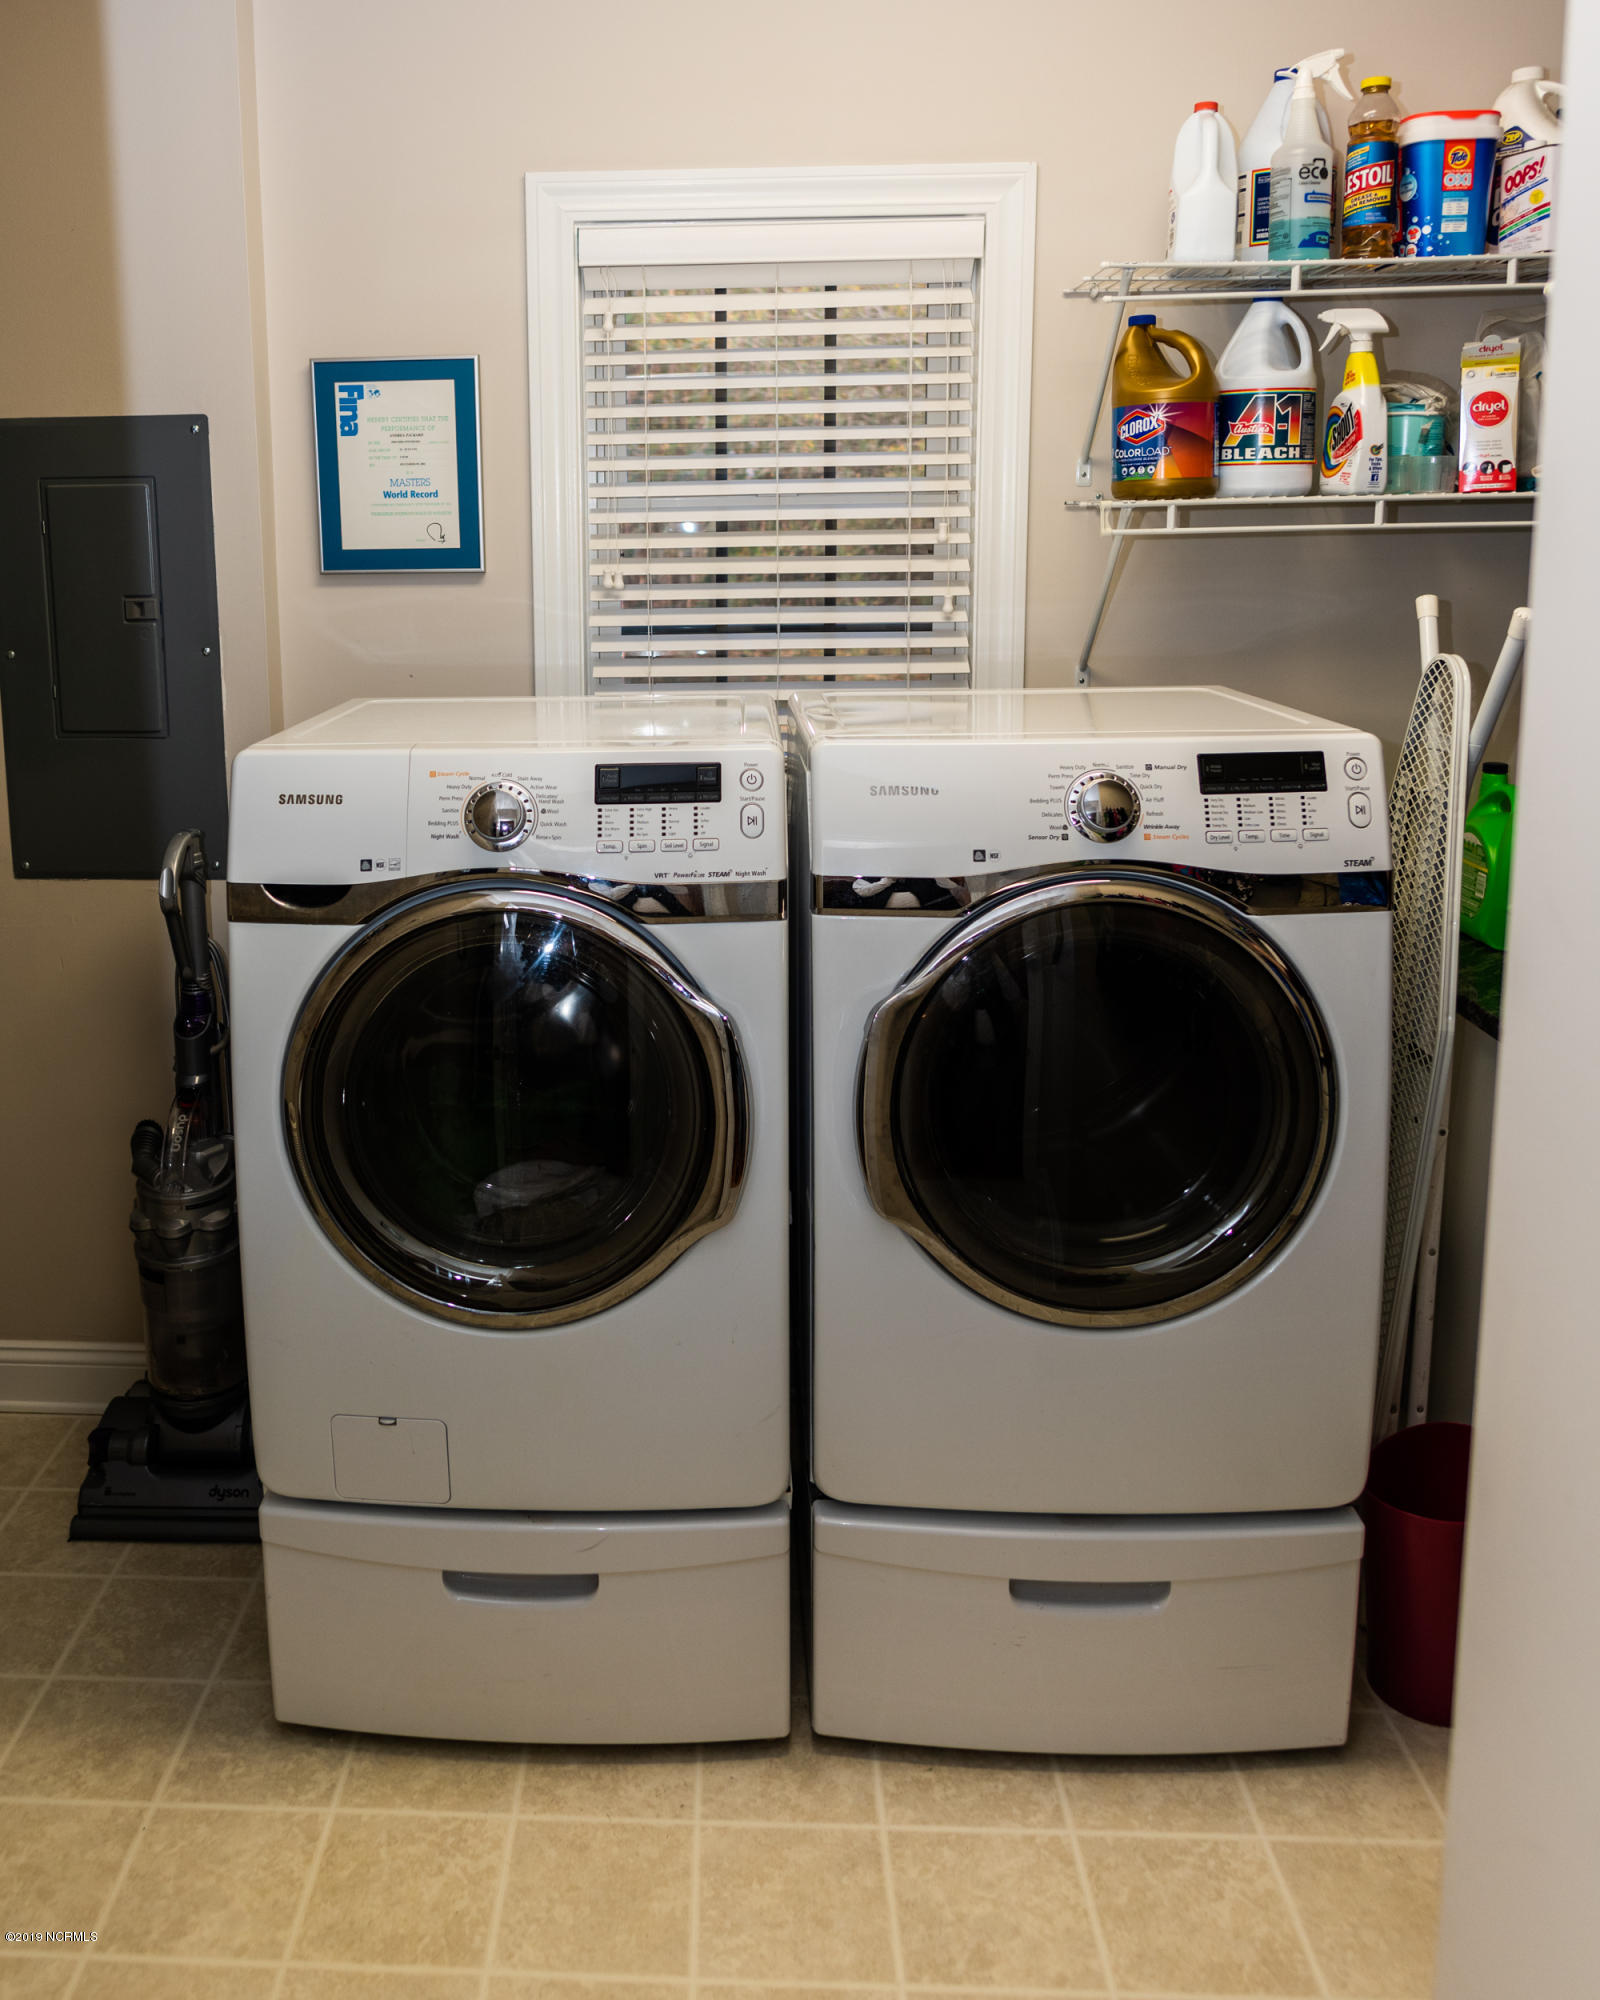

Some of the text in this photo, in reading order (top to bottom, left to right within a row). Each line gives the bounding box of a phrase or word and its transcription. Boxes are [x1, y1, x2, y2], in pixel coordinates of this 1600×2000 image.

[1451, 151, 1468, 164] Tide
[1299, 163, 1329, 180] eco
[1504, 155, 1545, 193] OOPS!
[1344, 164, 1392, 196] ESTOIL
[1443, 173, 1472, 187] OXI
[1473, 400, 1506, 414] dryel
[1120, 415, 1159, 440] CLOROX
[1233, 422, 1270, 434] Austin's
[1332, 402, 1354, 451] SHOUT
[1114, 447, 1170, 459] COLORLOAD
[1221, 447, 1300, 460] BLEACH
[389, 478, 431, 487] MASTERS
[383, 490, 439, 498] World Record
[278, 793, 343, 805] SAMSUNG
[1343, 859, 1373, 868] STEAM
[735, 870, 750, 878] Night
[171, 1114, 189, 1152] dyson
[208, 1485, 250, 1501] dyson
